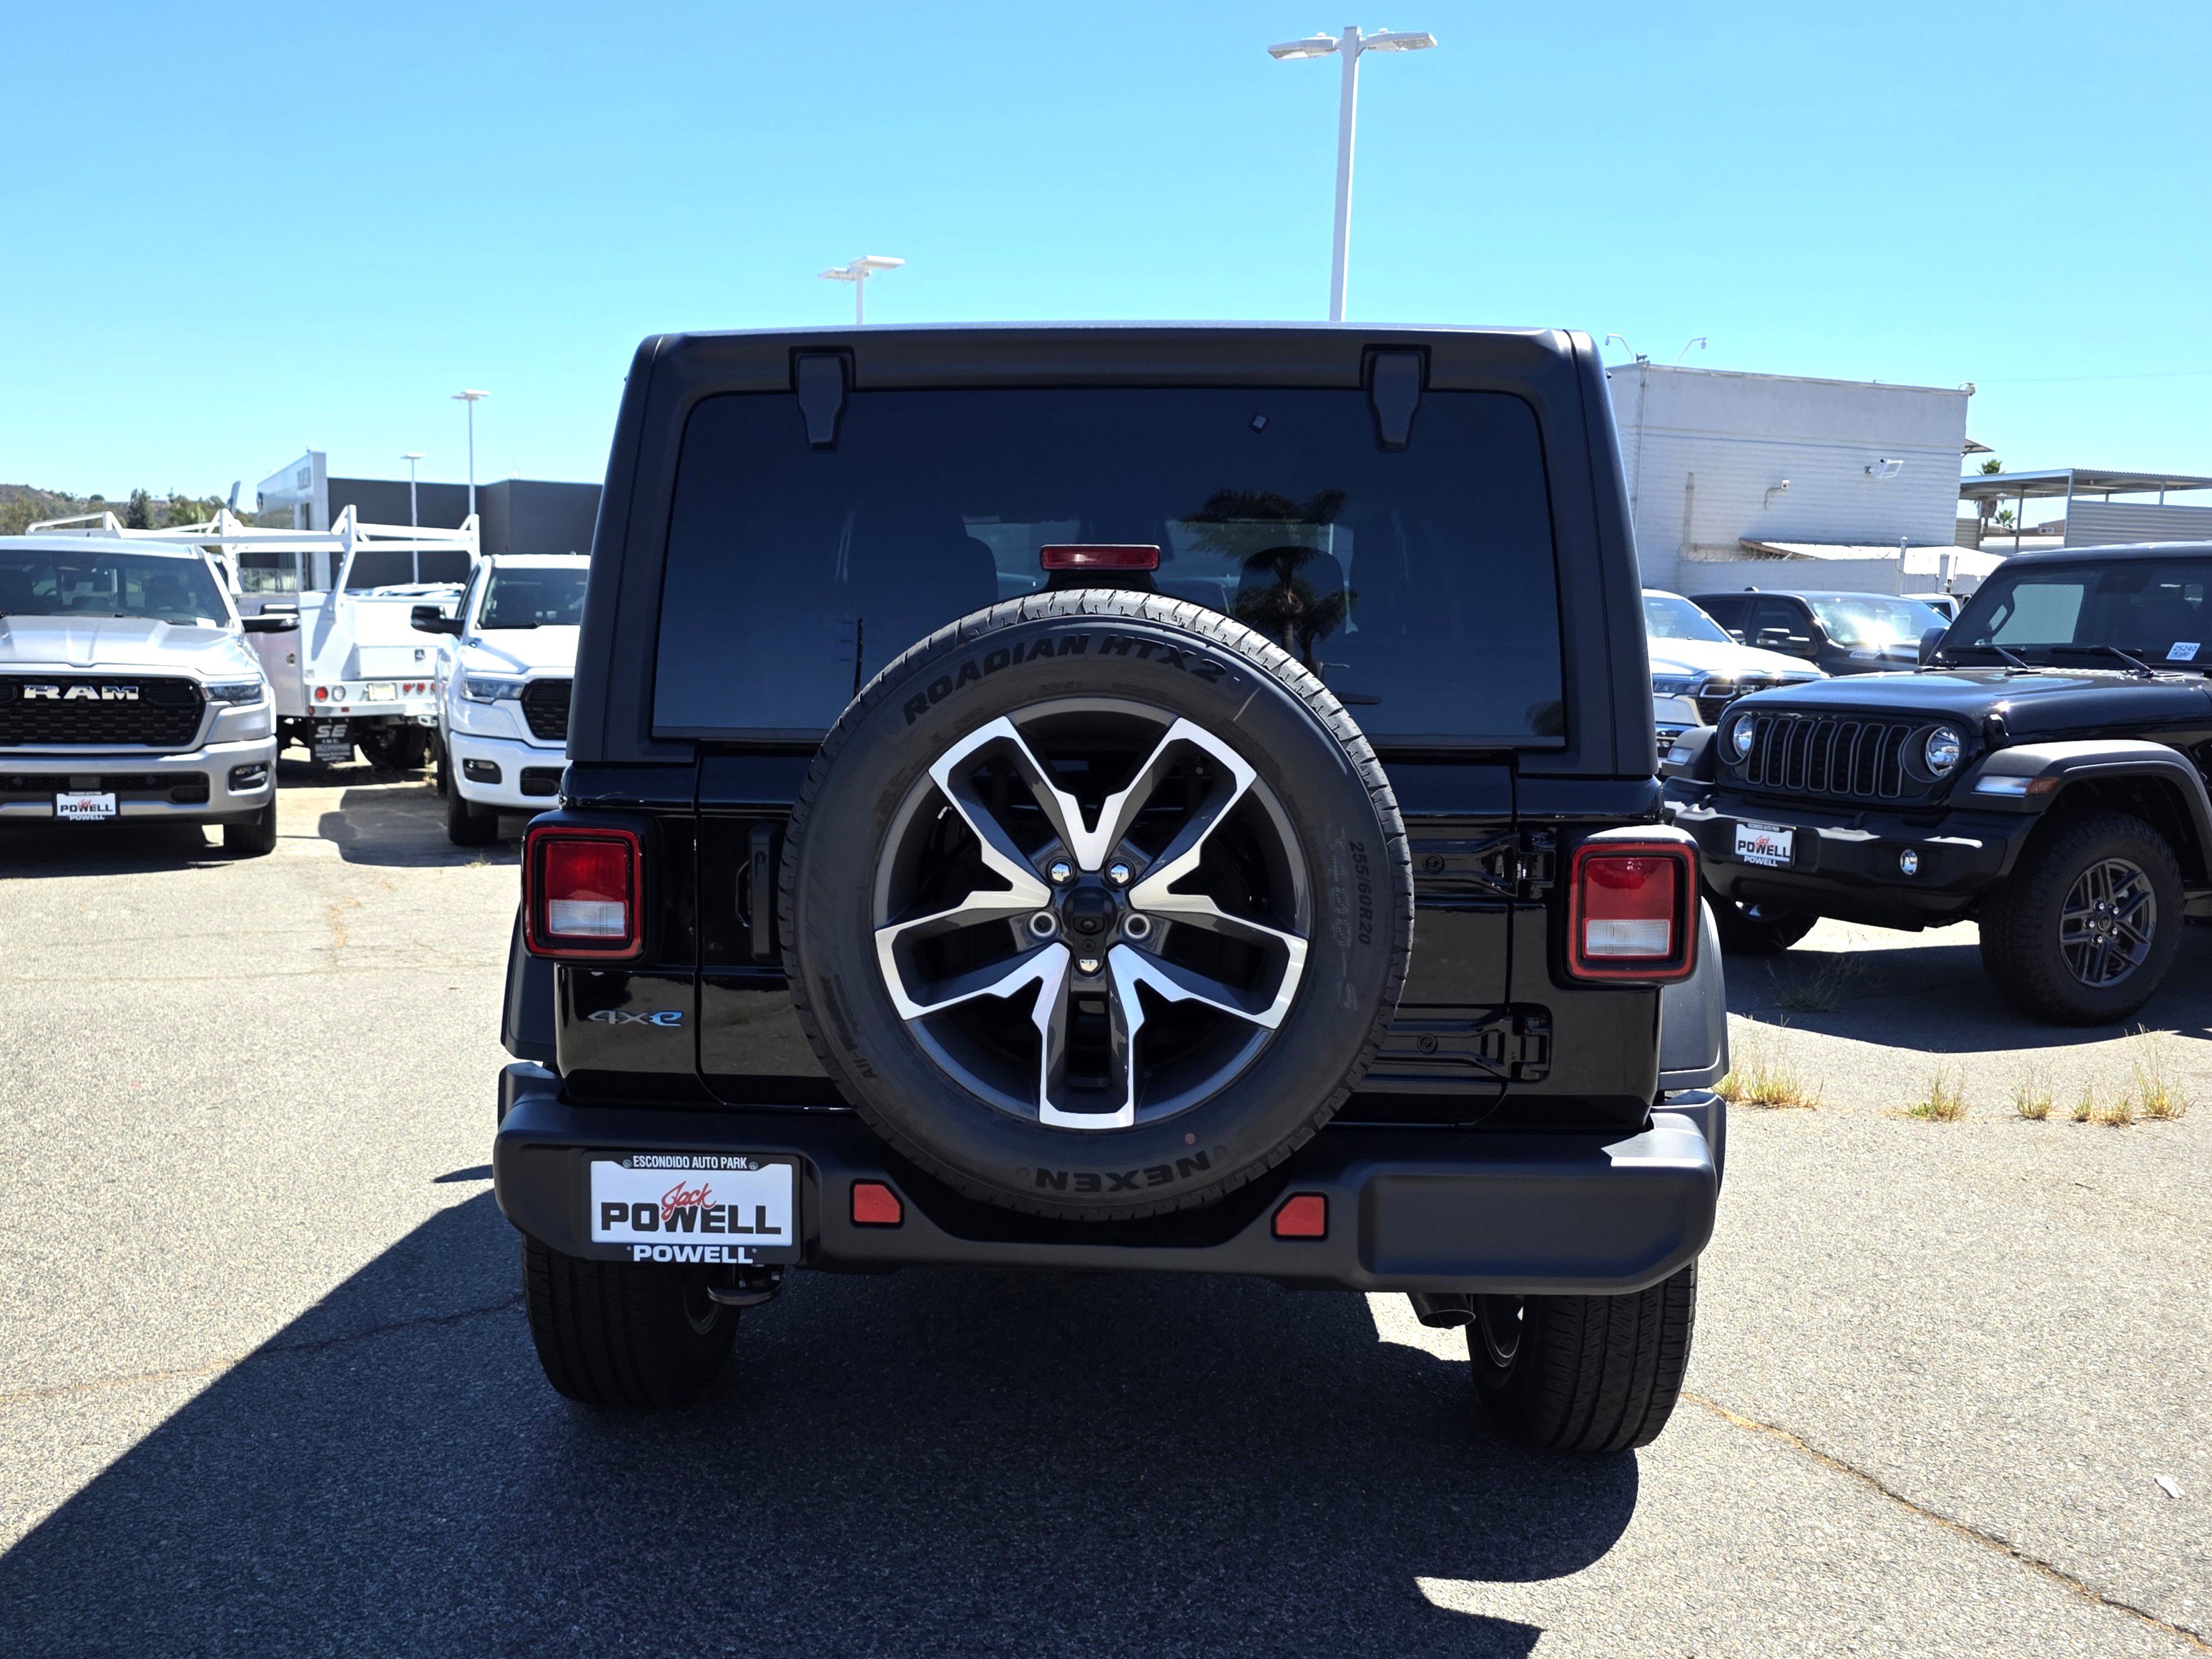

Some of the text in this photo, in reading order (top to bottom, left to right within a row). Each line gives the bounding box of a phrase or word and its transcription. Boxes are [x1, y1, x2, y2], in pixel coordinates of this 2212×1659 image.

[903, 634, 1091, 726] ROADIAN
[24, 684, 139, 700] RAM
[315, 724, 348, 738] SE
[60, 804, 113, 812] POWELL
[1738, 840, 1791, 858] POWELL
[1744, 855, 1778, 867] POWELL
[1350, 841, 1372, 945] 255/60R20
[632, 1155, 747, 1170] ESCONDIDO AUTO PARK
[1035, 1150, 1211, 1193] NEXEN
[661, 1181, 717, 1221] Jack
[601, 1201, 782, 1235] POWELL
[633, 1245, 753, 1264] POWELL
